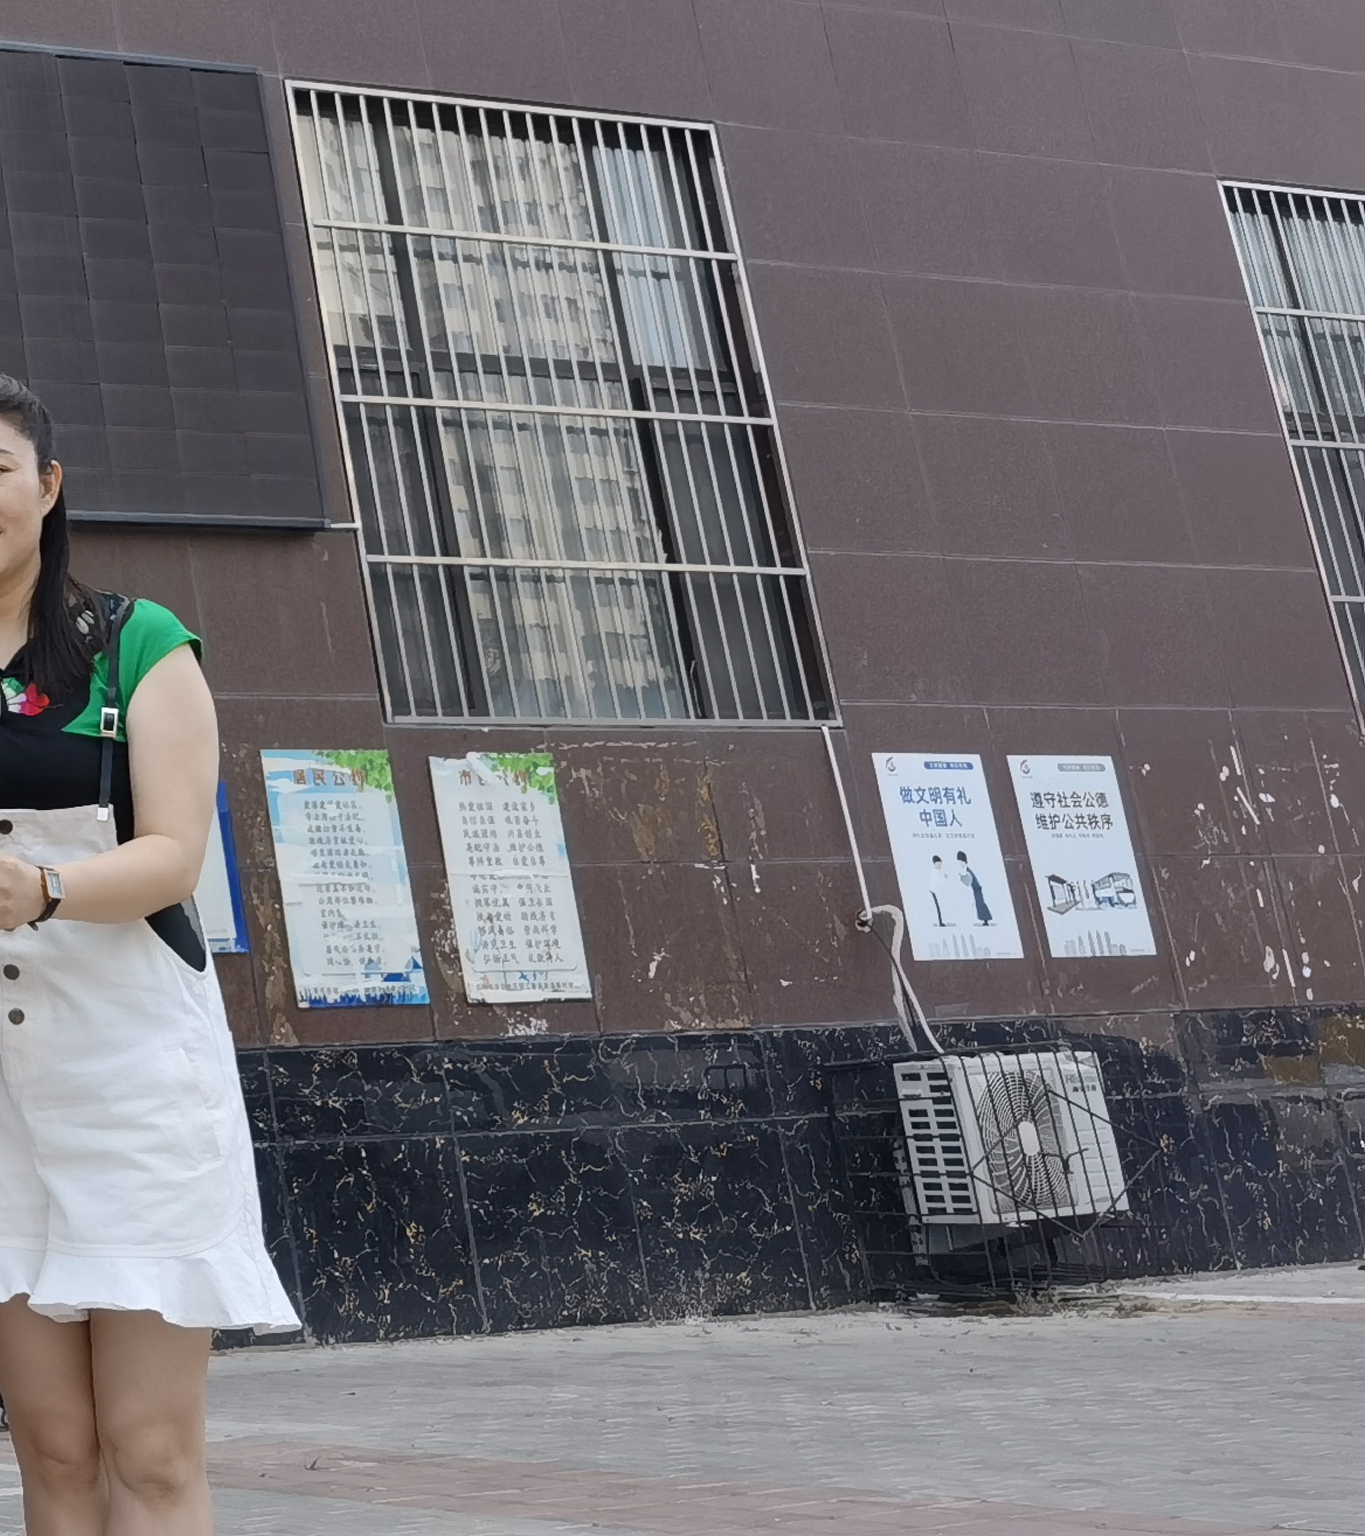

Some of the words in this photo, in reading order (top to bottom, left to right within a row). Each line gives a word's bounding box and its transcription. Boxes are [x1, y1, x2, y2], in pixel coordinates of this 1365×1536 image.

[899, 786, 972, 805] 做文明有礼
[1029, 790, 1110, 809] 遵守社会公德
[919, 808, 964, 828] 中国人
[1034, 812, 1114, 831] 维护公共秩序
